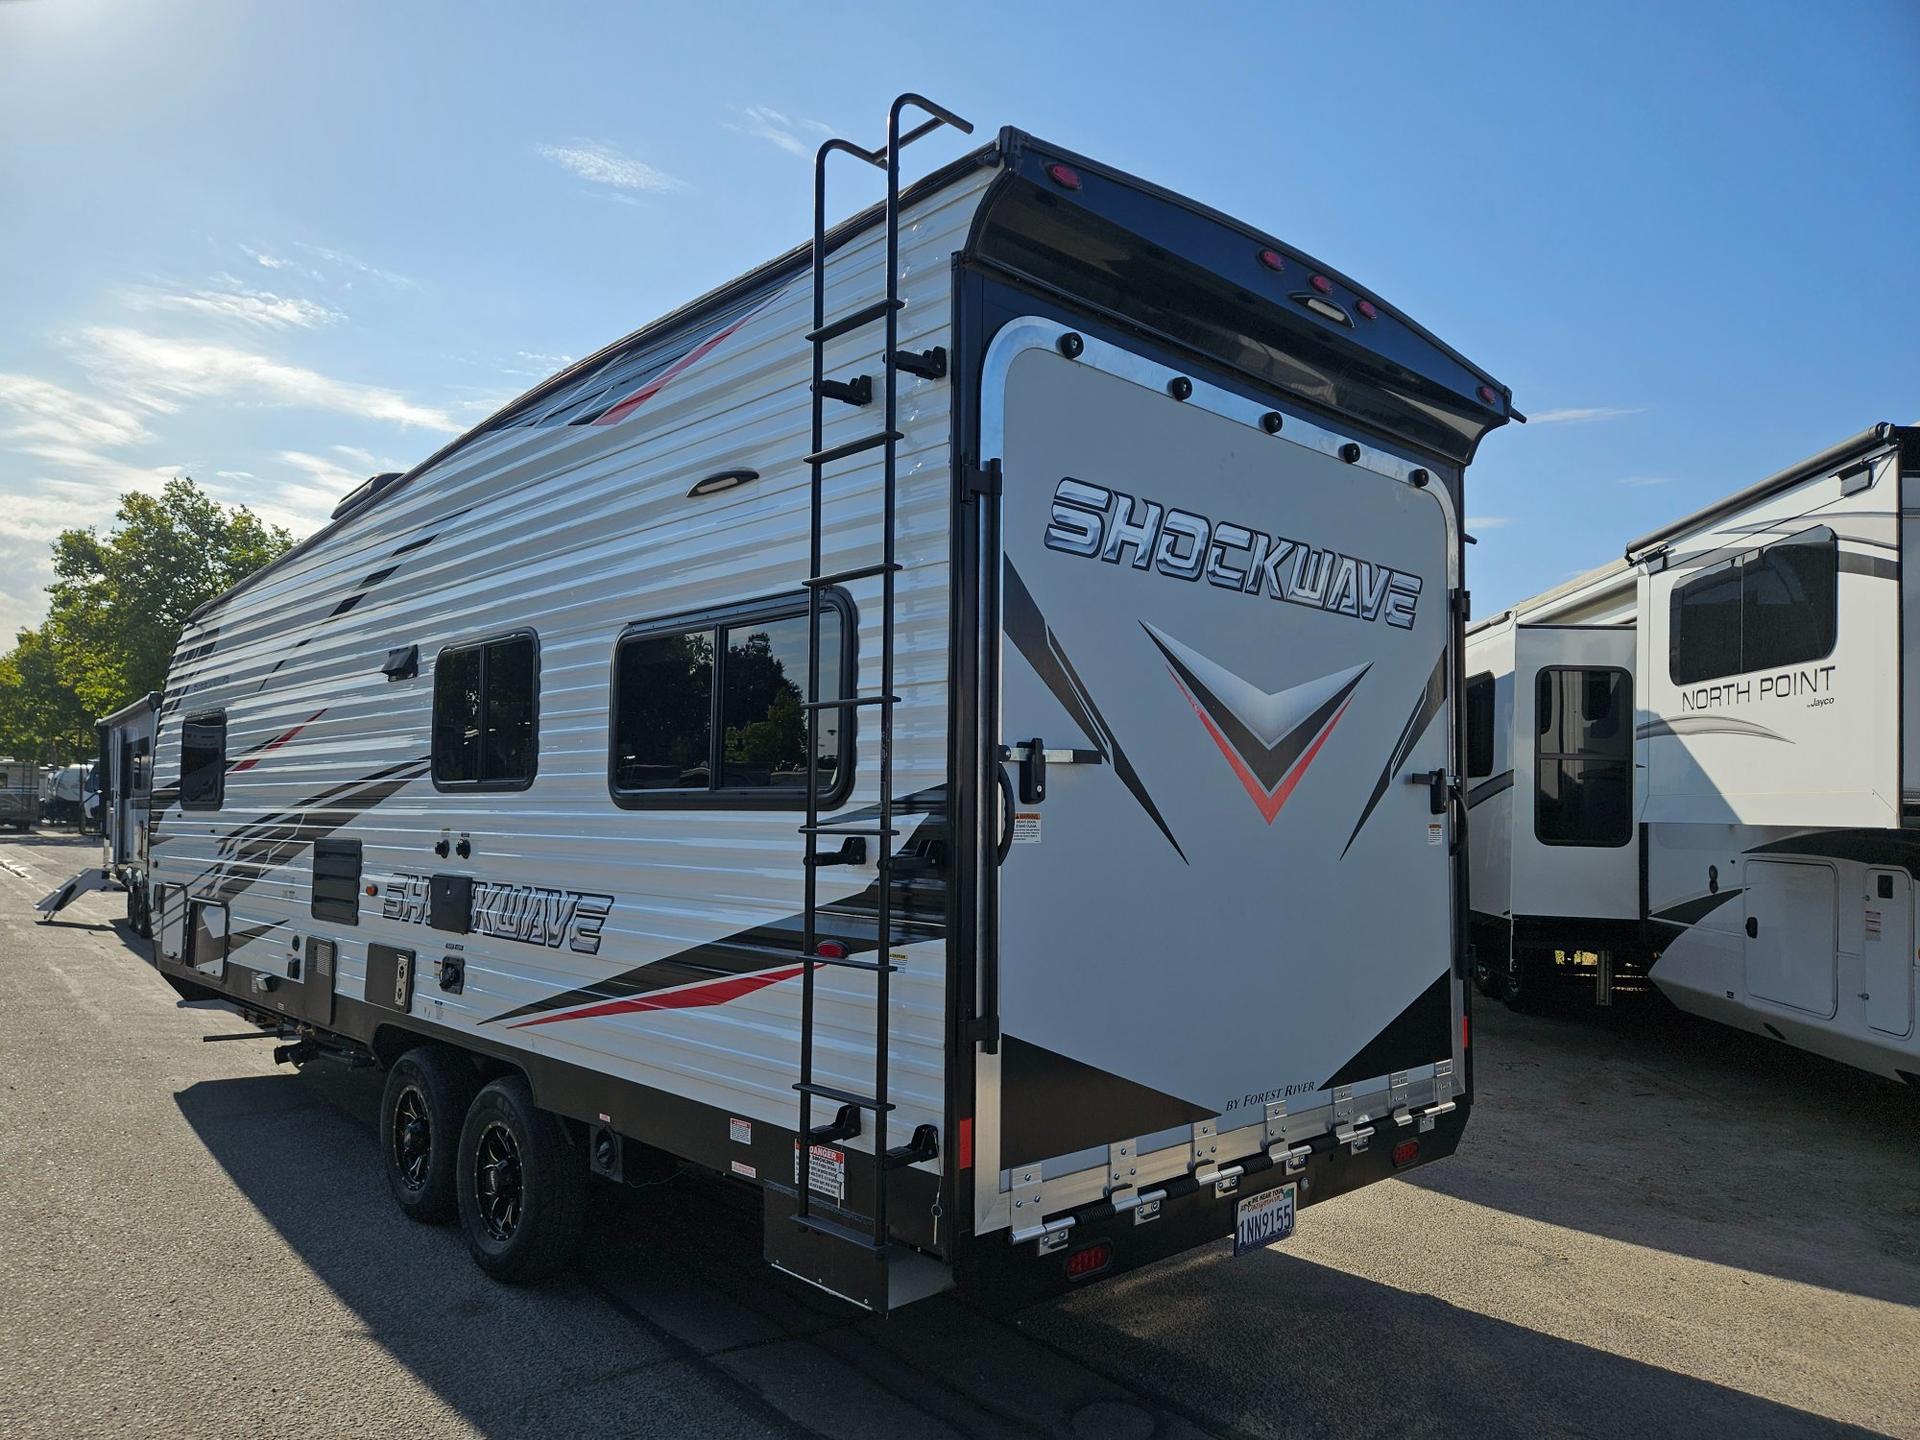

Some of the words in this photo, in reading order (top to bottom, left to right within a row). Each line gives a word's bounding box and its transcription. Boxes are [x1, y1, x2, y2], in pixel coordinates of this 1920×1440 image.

[1044, 476, 1423, 631] SHOCKWAVE
[1682, 680, 1750, 712] NORTH
[1760, 665, 1836, 701] POINT
[1811, 697, 1835, 709] Jayco
[382, 873, 615, 955] SHKWAVE
[1226, 1100, 1240, 1111] BY
[1243, 1088, 1283, 1107] FOREST
[1284, 1081, 1315, 1097] RIVER
[810, 1145, 837, 1161] DANGER
[1240, 1204, 1291, 1247] 1NN9155
